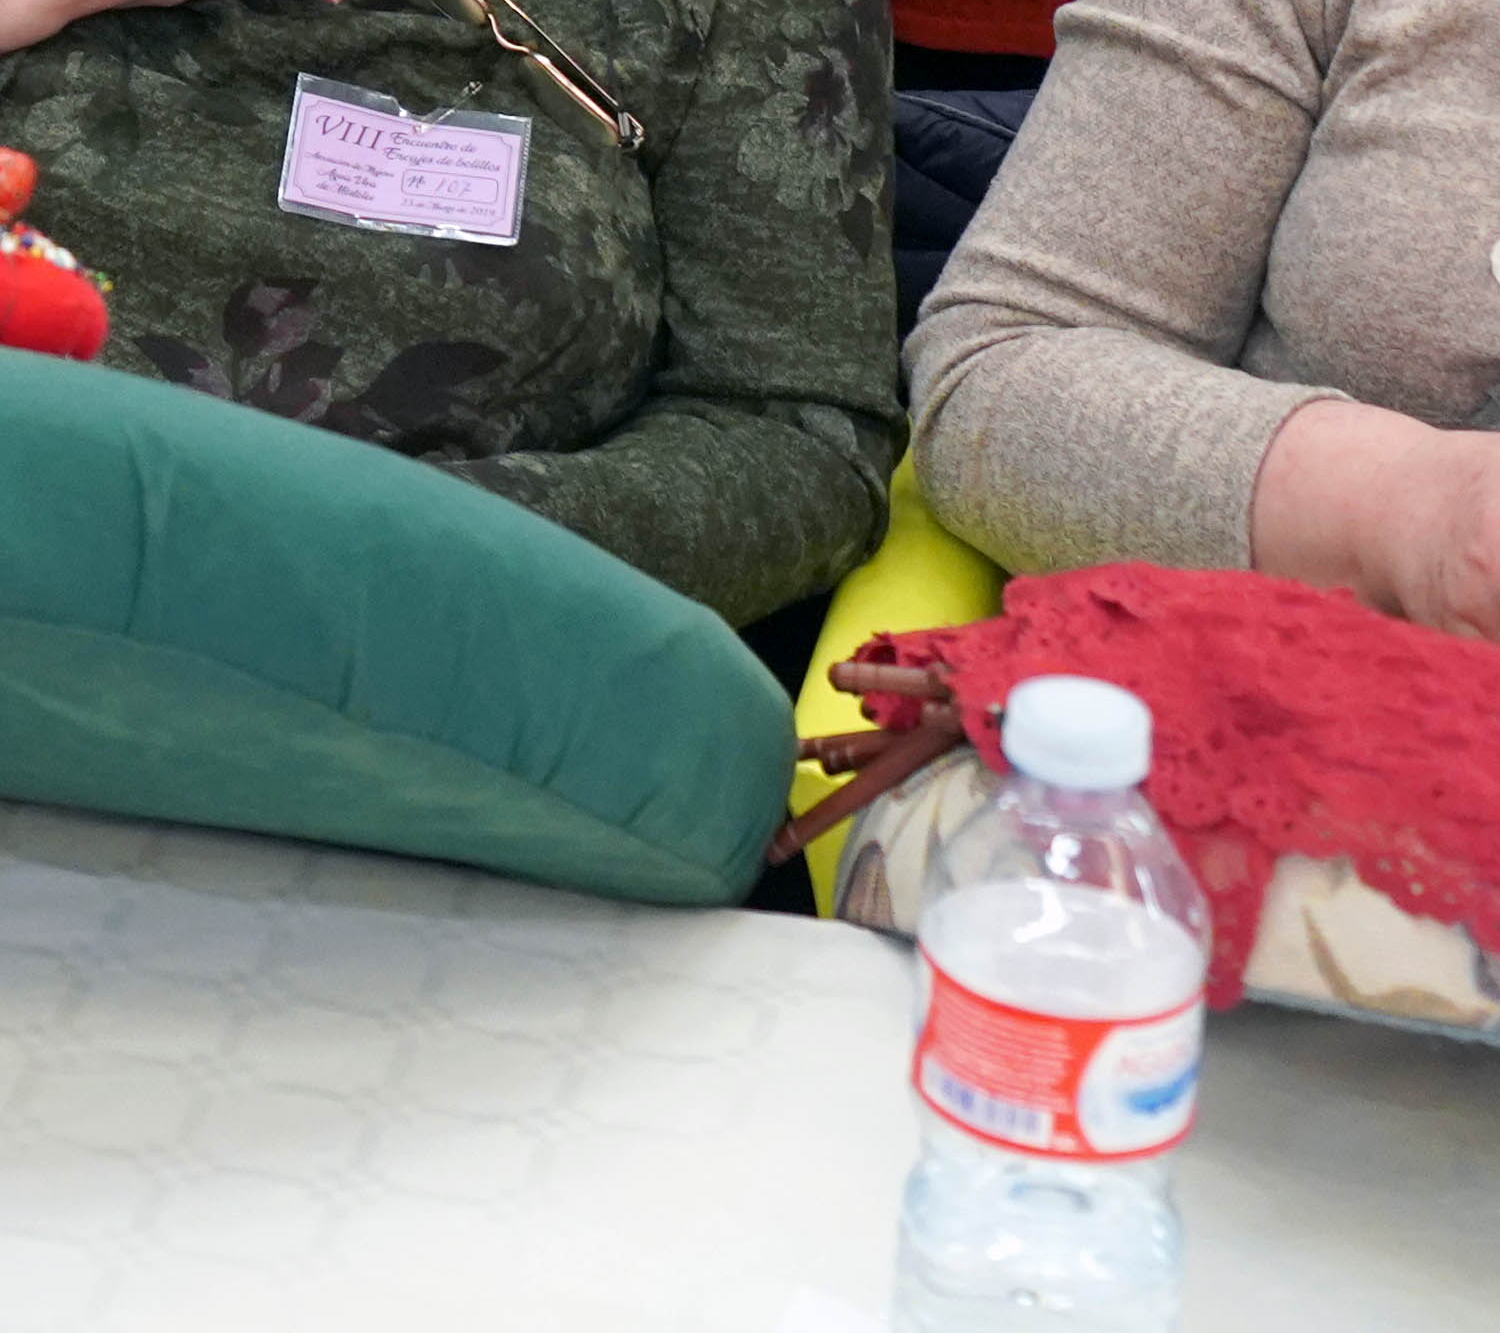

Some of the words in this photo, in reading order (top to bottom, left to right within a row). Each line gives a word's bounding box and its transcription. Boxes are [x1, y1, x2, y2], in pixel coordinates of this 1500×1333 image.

[315, 114, 385, 150] VIII
[389, 132, 457, 153] Encuentro
[383, 146, 433, 166] Encajes
[456, 156, 501, 172] bolillos
